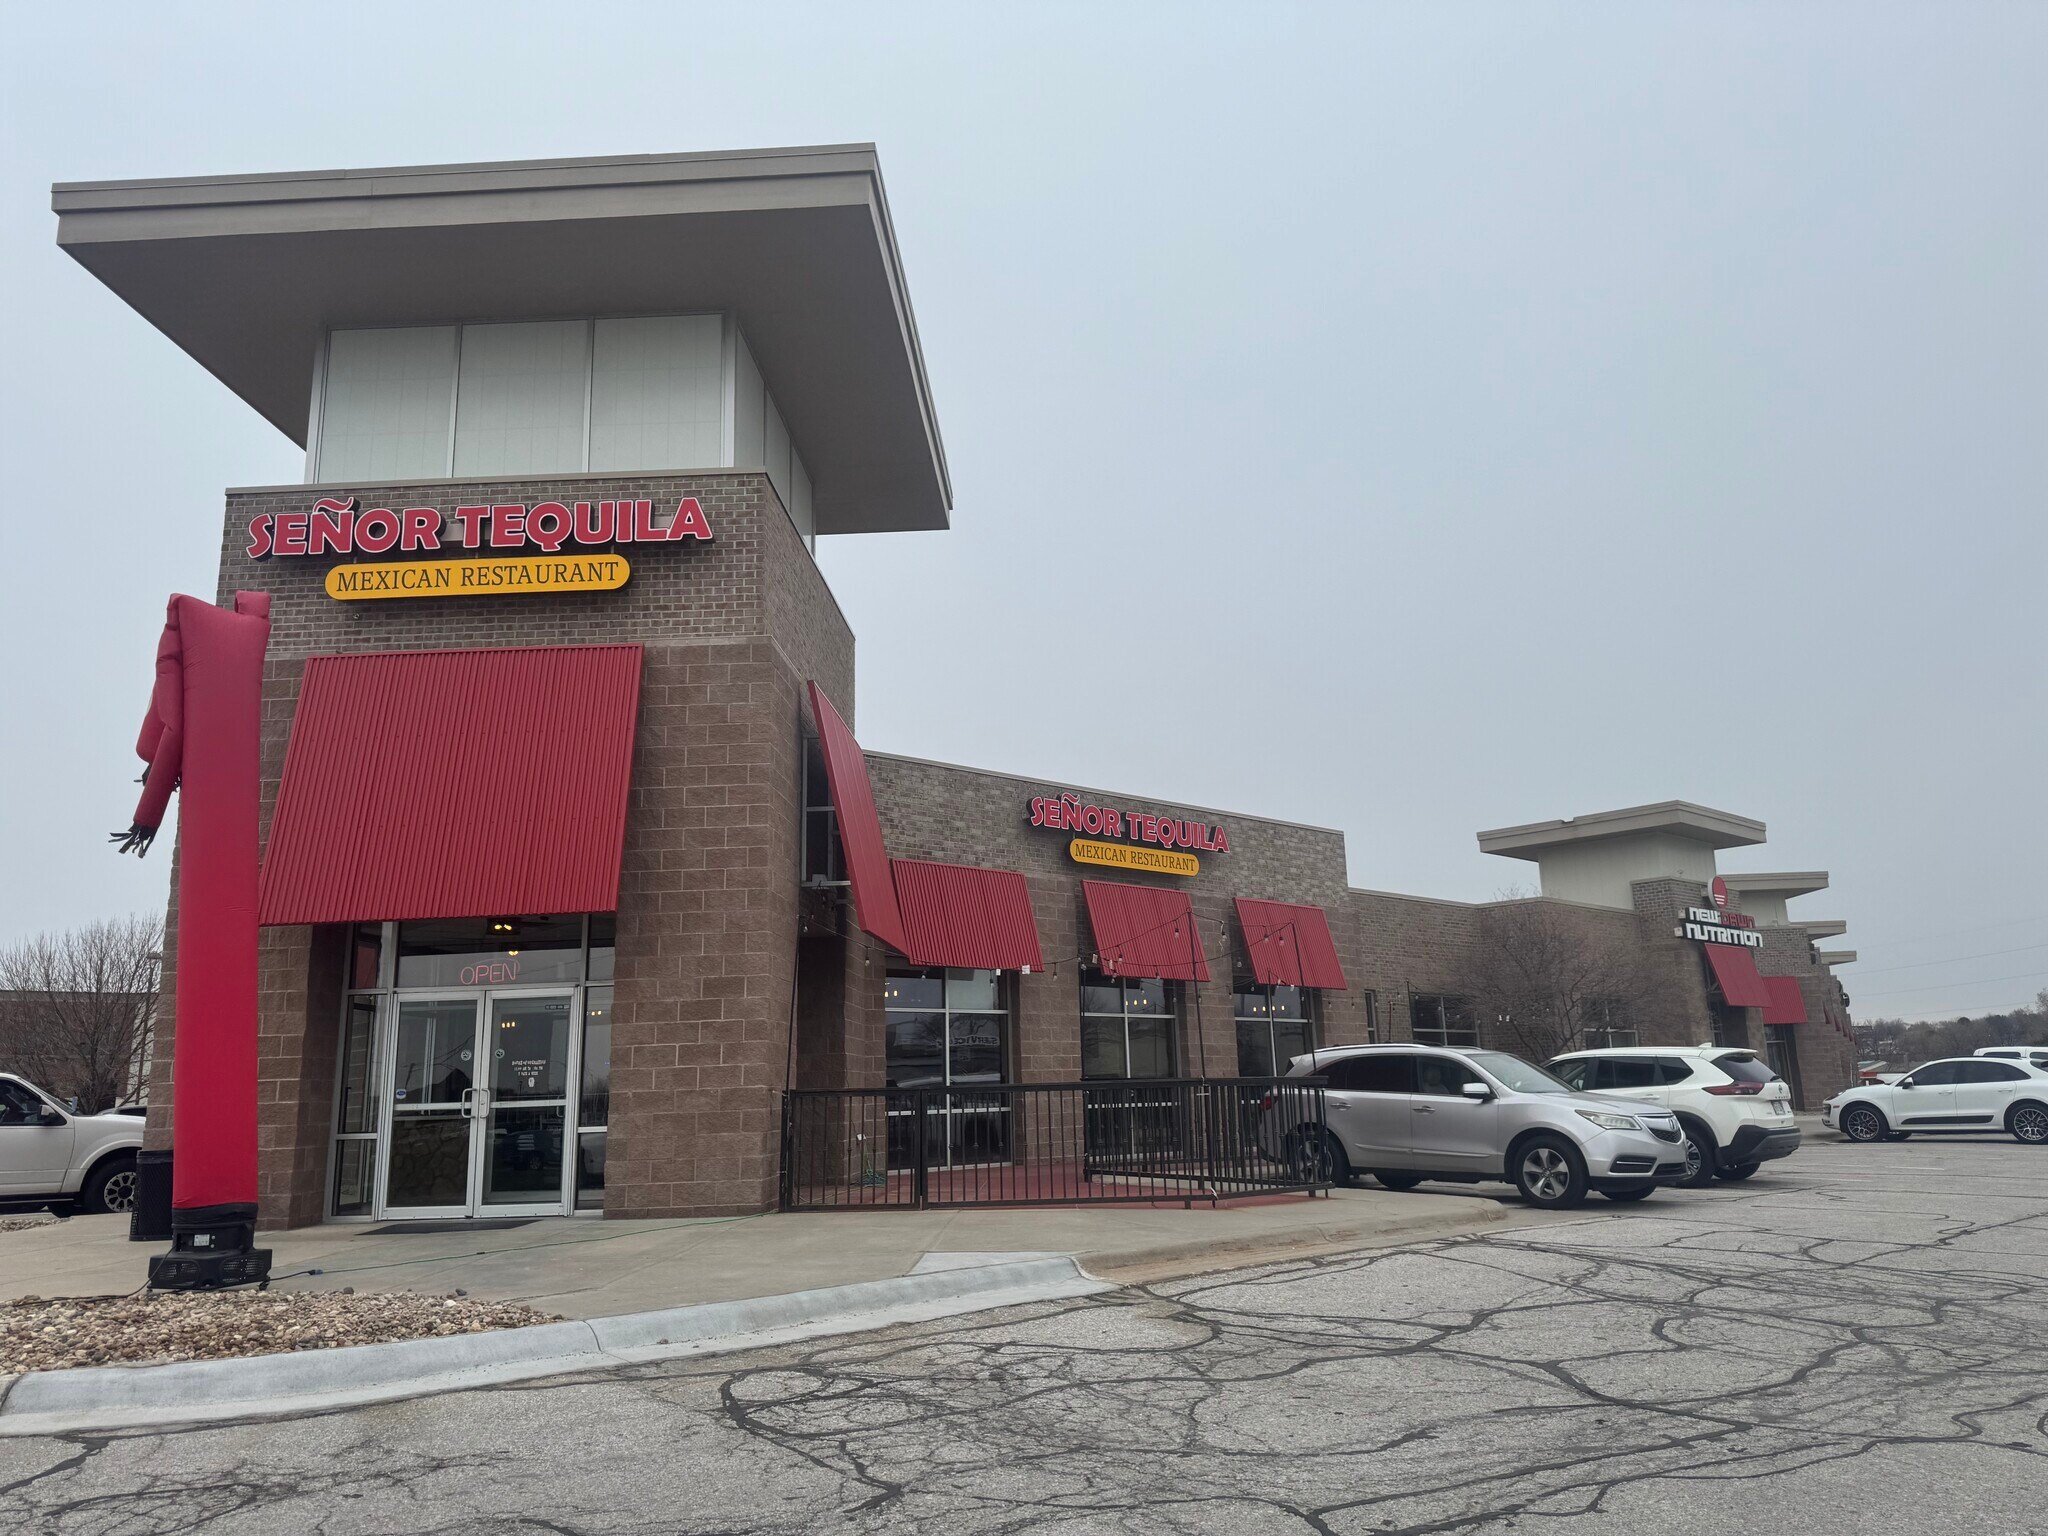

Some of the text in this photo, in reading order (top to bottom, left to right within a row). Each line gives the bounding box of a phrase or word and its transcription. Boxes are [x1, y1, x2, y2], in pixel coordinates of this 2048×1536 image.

[246, 497, 713, 560] SEÑOR TEQUILA
[336, 561, 620, 593] MEXICAN RESTAURANT
[1030, 793, 1230, 853] SEÑOR TEQUILA
[1075, 844, 1196, 873] MEXICAN RESTAURANT
[460, 961, 517, 985] OPEN
